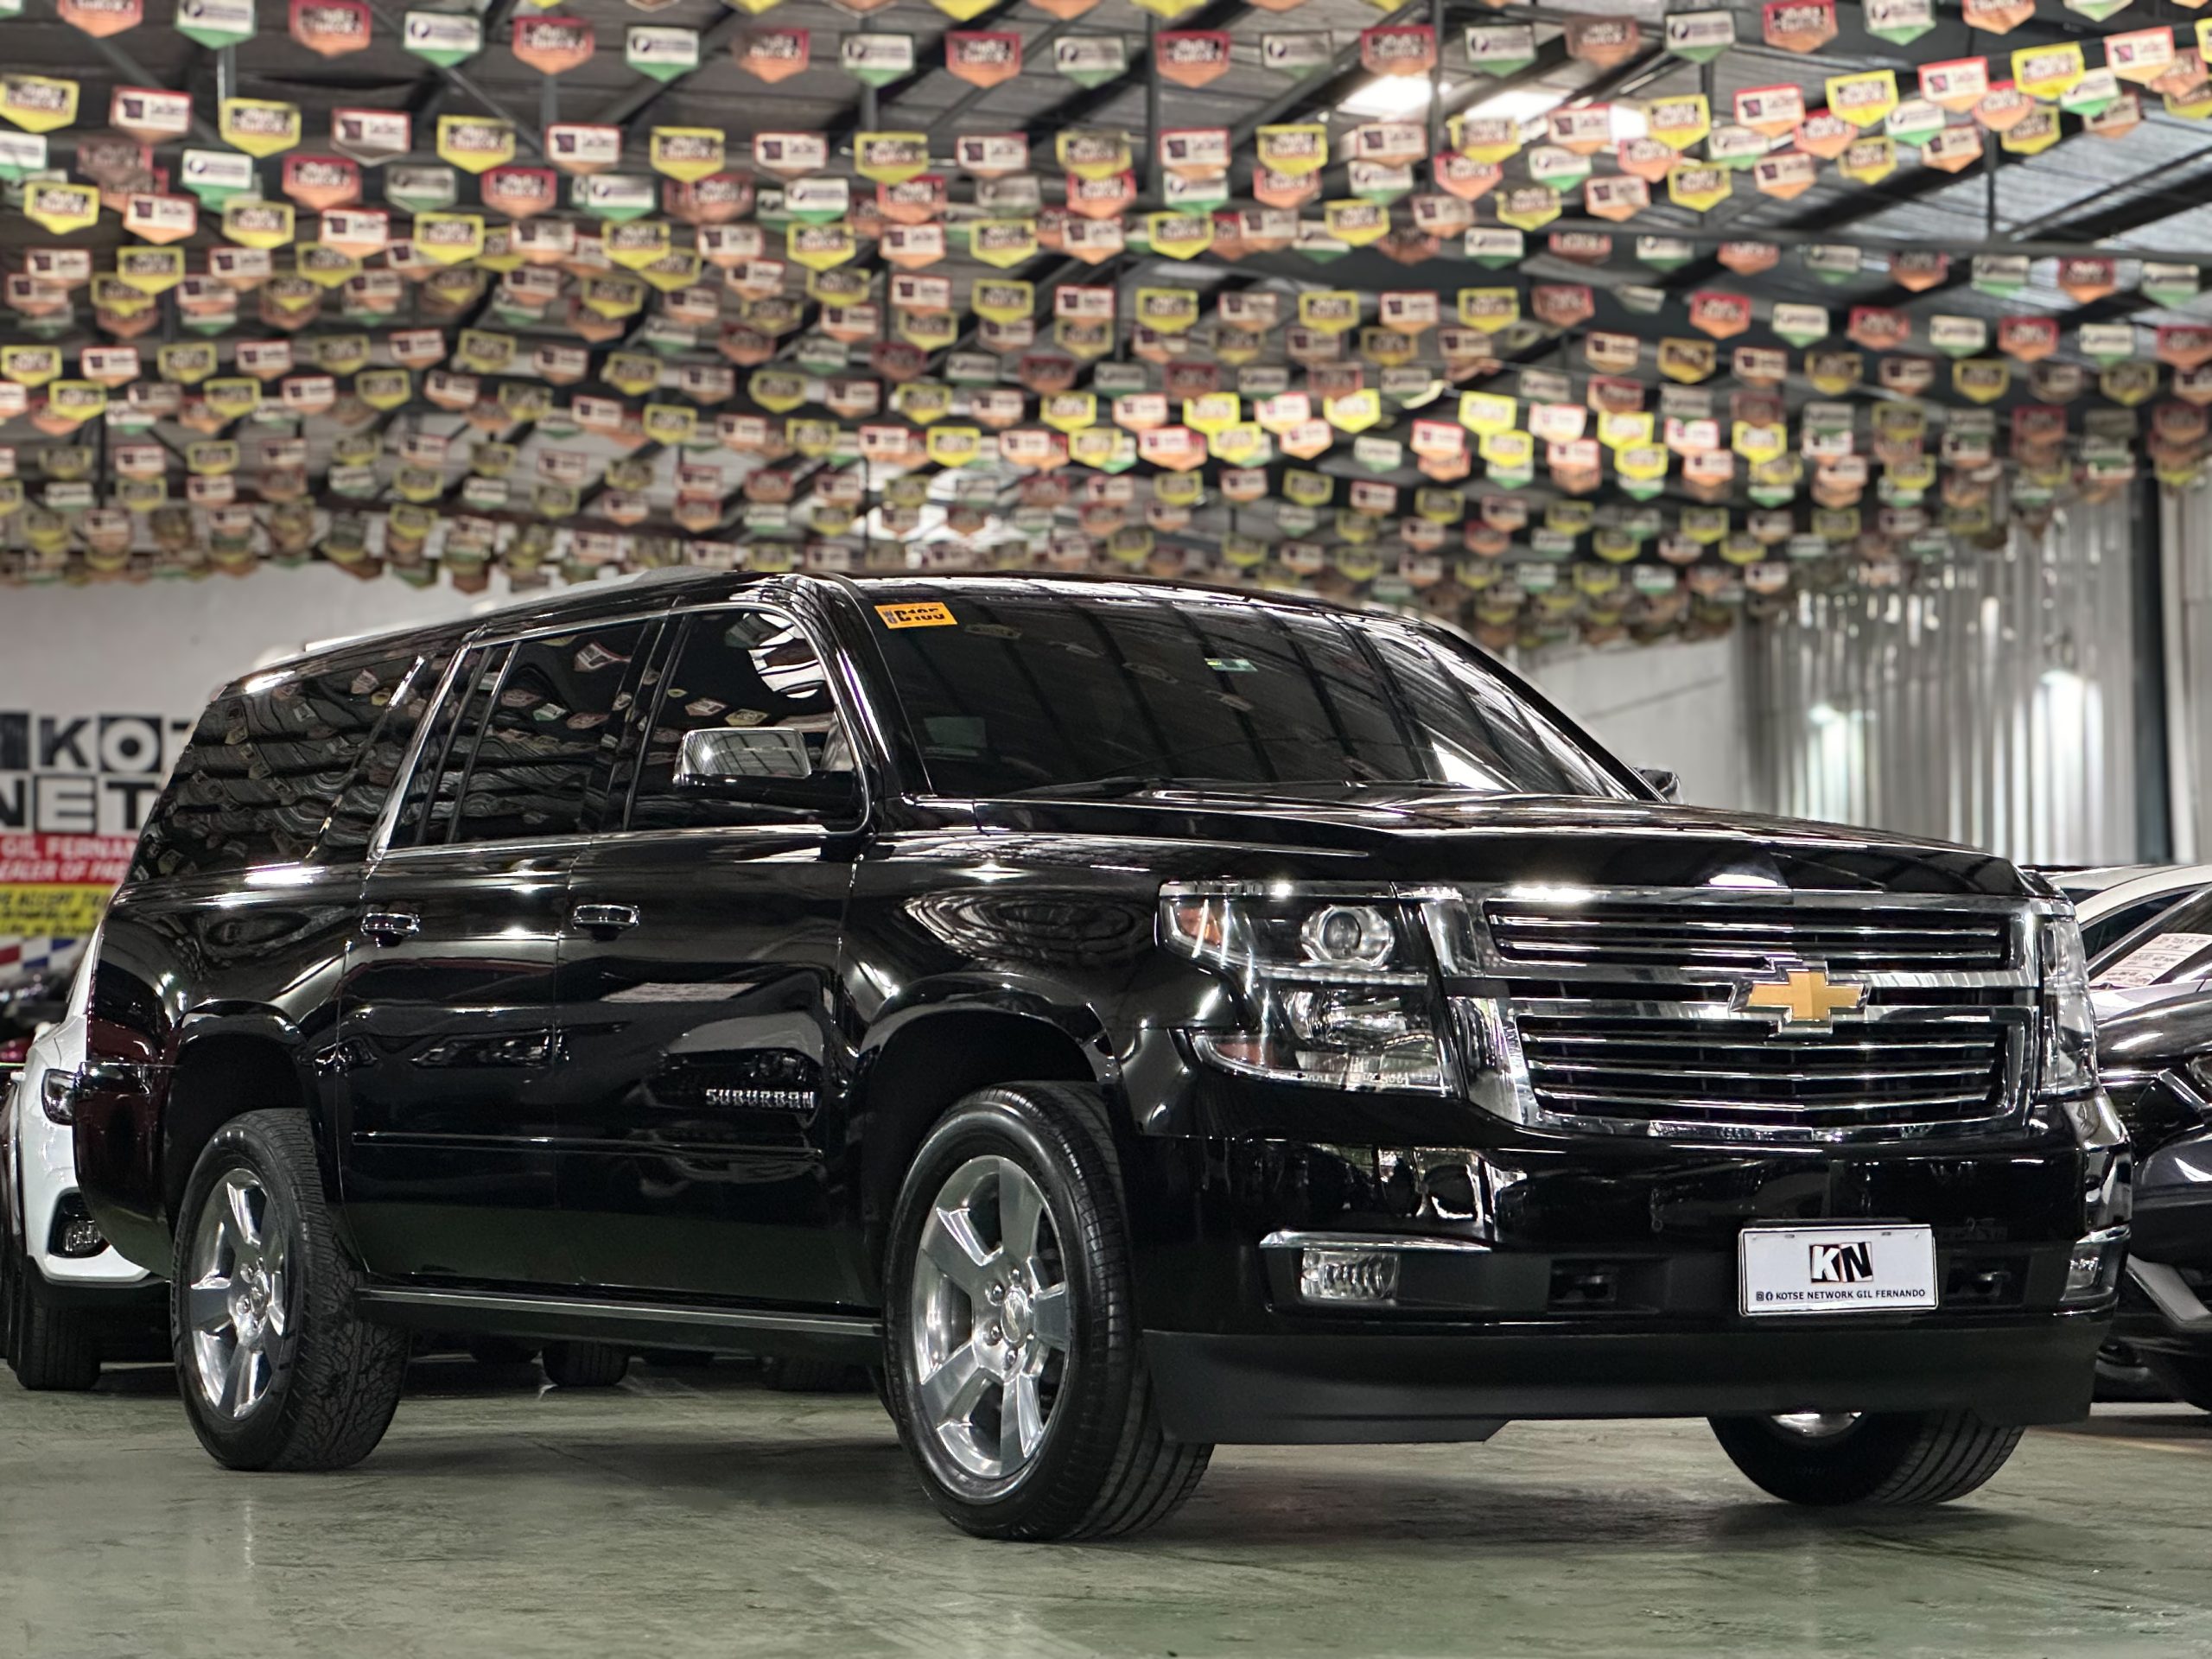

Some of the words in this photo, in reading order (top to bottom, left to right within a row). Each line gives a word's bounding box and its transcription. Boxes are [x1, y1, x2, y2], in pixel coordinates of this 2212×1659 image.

[706, 1089, 815, 1109] SUBURBAN
[1809, 1242, 1872, 1283] KN
[1776, 1291, 1804, 1300] KOTSE
[1807, 1290, 1853, 1300] NETWORK
[1857, 1290, 1872, 1299] GIL
[1875, 1288, 1926, 1298] FERNANDO
